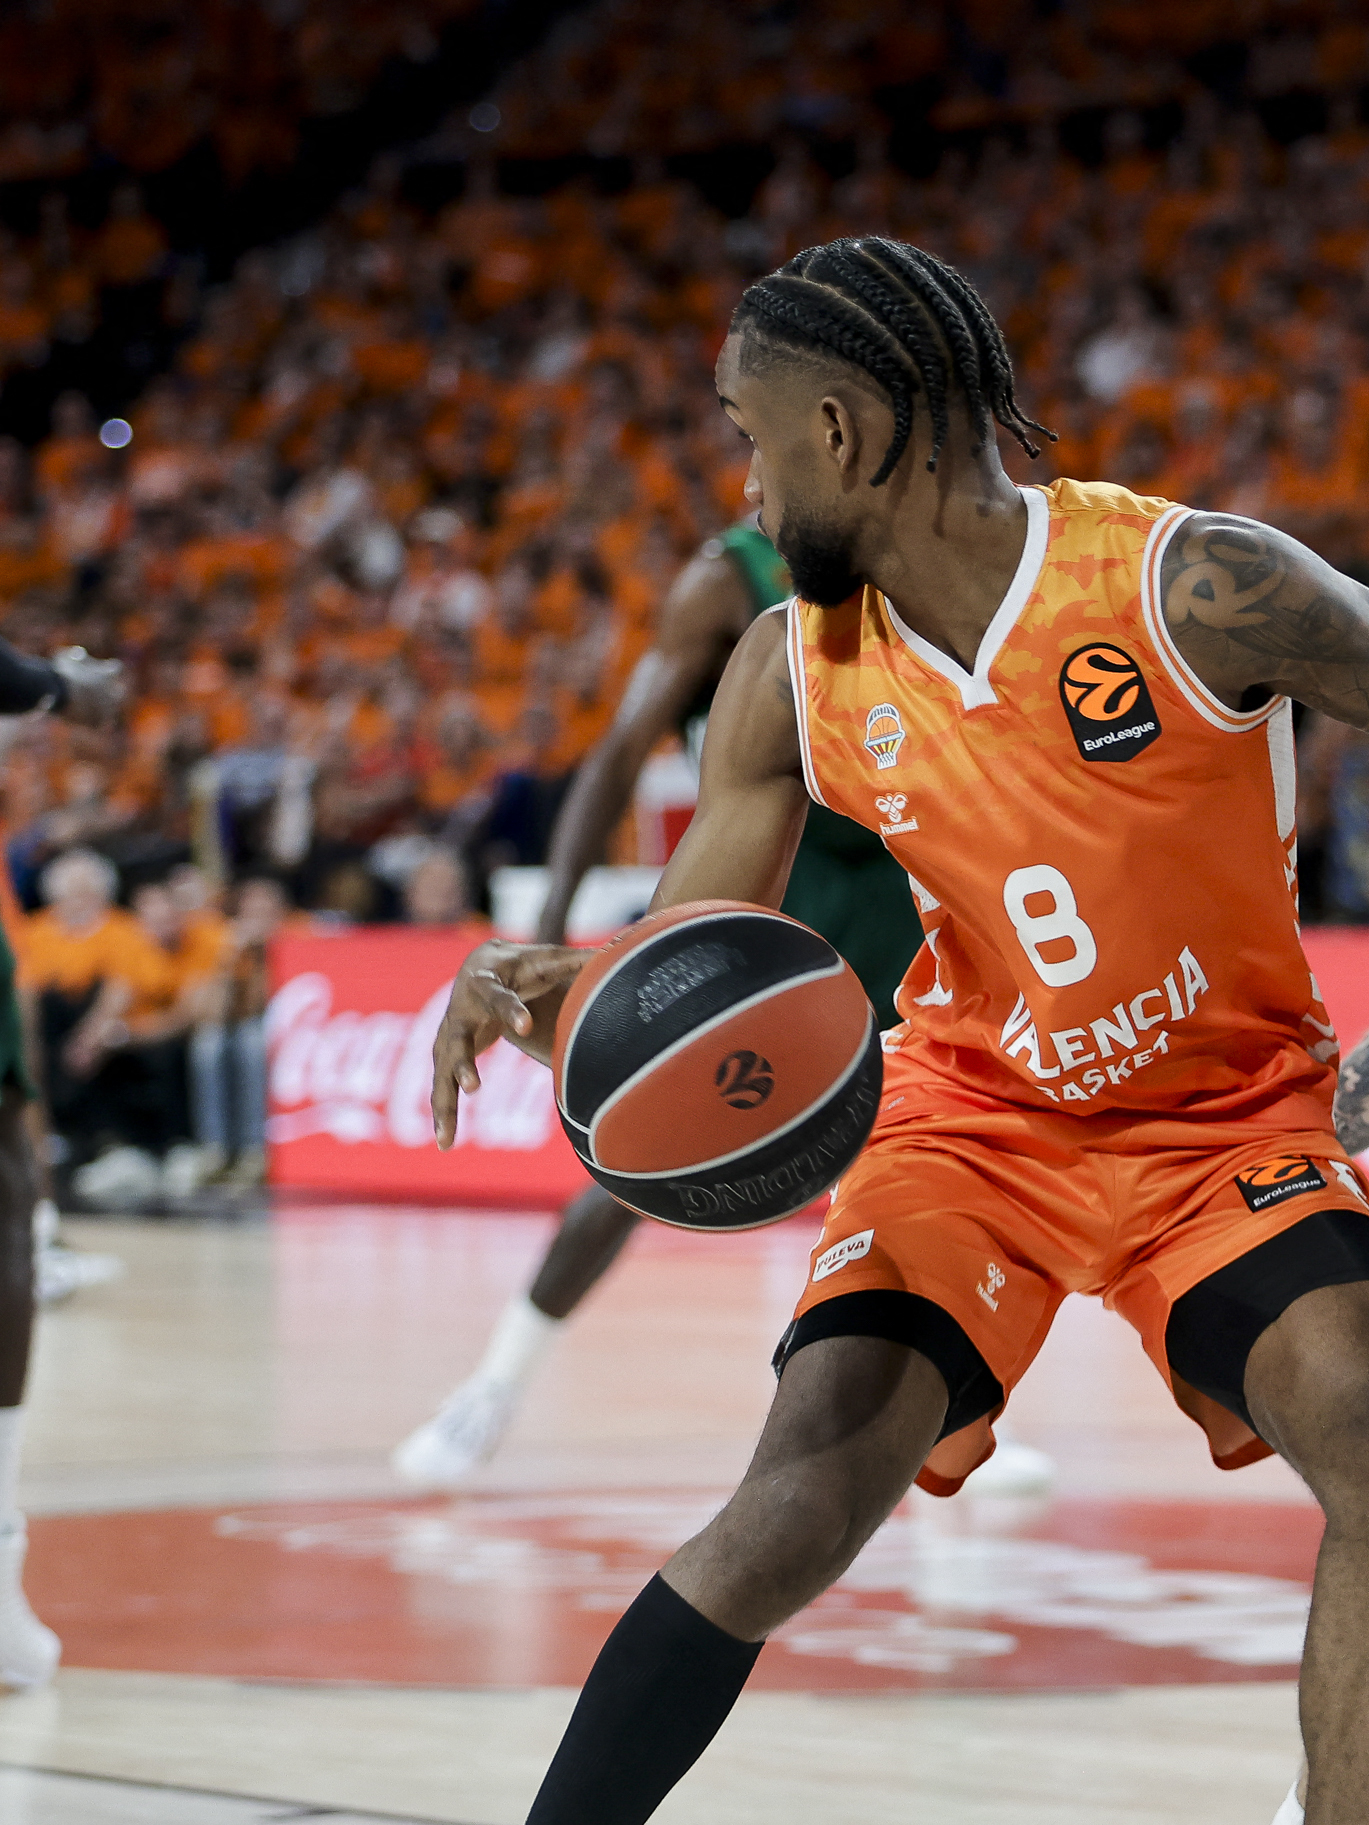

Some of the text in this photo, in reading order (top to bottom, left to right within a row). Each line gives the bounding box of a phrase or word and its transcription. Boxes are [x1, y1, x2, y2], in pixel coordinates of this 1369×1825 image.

[1083, 721, 1155, 751] EuroLeague
[881, 817, 918, 835] hummel
[1003, 864, 1097, 987] 8
[1000, 945, 1209, 1079] VALENCIA
[1252, 1179, 1321, 1207] EuroLeague
[816, 1240, 865, 1273] PULEVA
